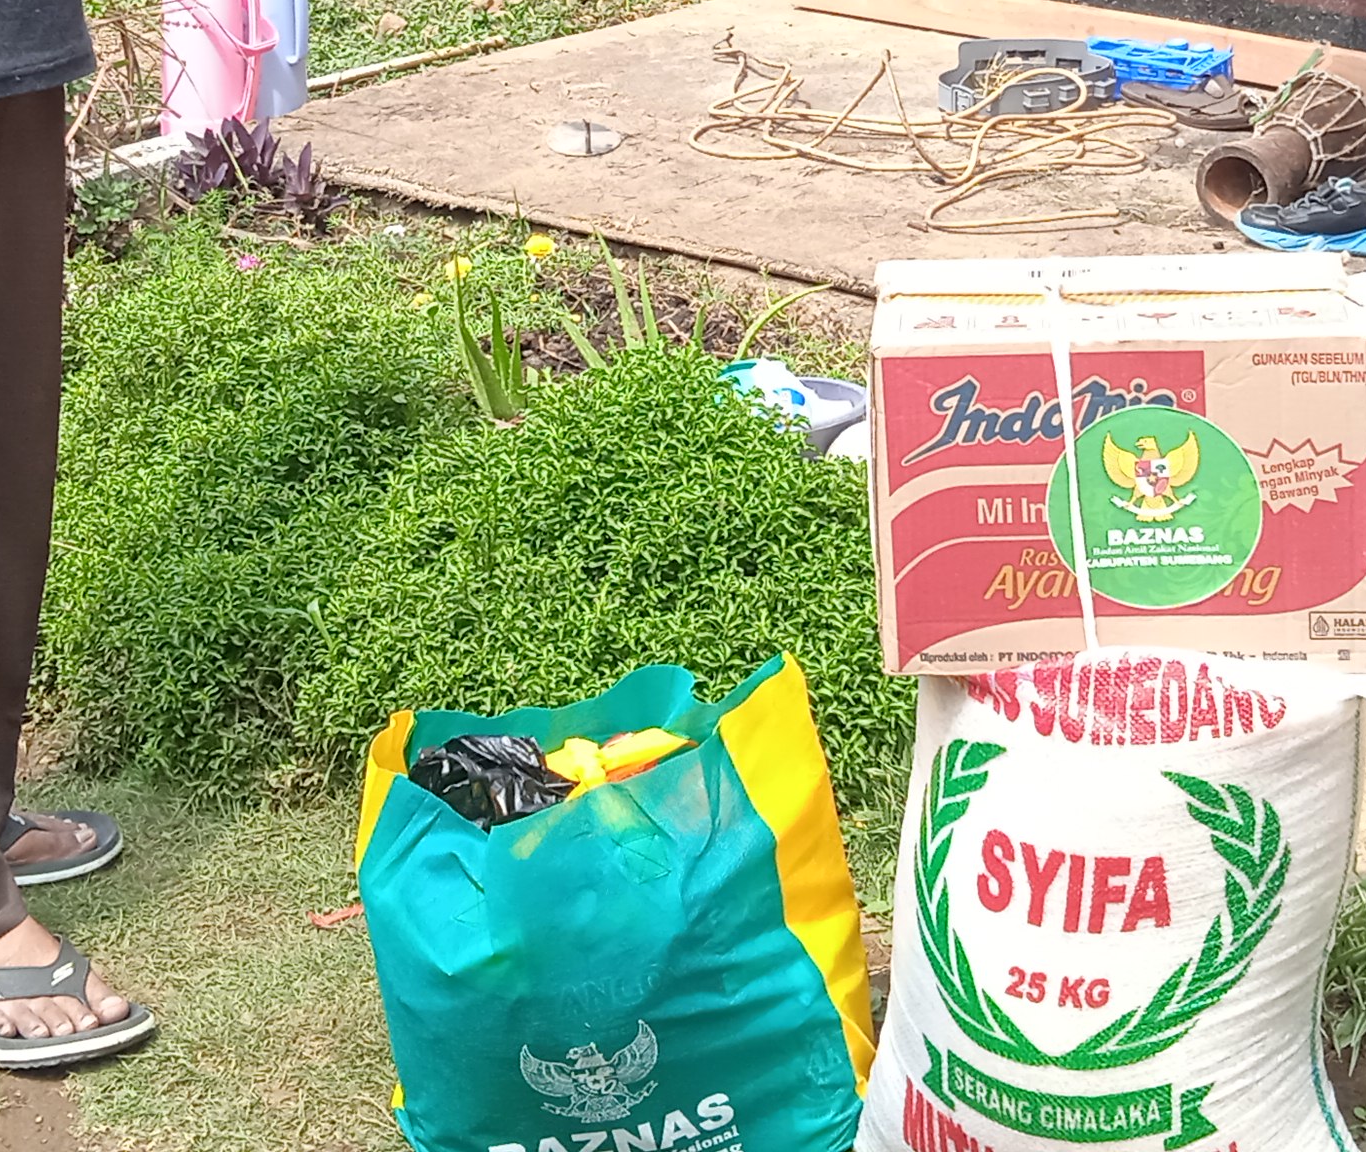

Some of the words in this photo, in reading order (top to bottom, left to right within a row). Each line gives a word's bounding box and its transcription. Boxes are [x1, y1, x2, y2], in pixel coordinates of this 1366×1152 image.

[1252, 353, 1308, 366] GUNAKAN
[1311, 352, 1364, 365] SEBELUM
[1261, 457, 1315, 475] Lengkap
[1259, 475, 1292, 490] ngan
[1295, 466, 1340, 484] Minyak
[1269, 484, 1320, 501] Bawang
[977, 497, 1013, 524] Mi
[1107, 526, 1205, 546] BAZNAS
[1019, 547, 1063, 566] Ras
[1087, 556, 1158, 568] KABUPATEN
[920, 652, 967, 663] Diproduksi
[969, 651, 988, 662] oleh
[998, 651, 1013, 662] PT
[977, 829, 1171, 934] SYIFA
[1004, 966, 1047, 1003] 25
[1058, 975, 1111, 1009] KG
[954, 1066, 1033, 1125] SERANG
[1040, 1098, 1161, 1133] CIMALAKA
